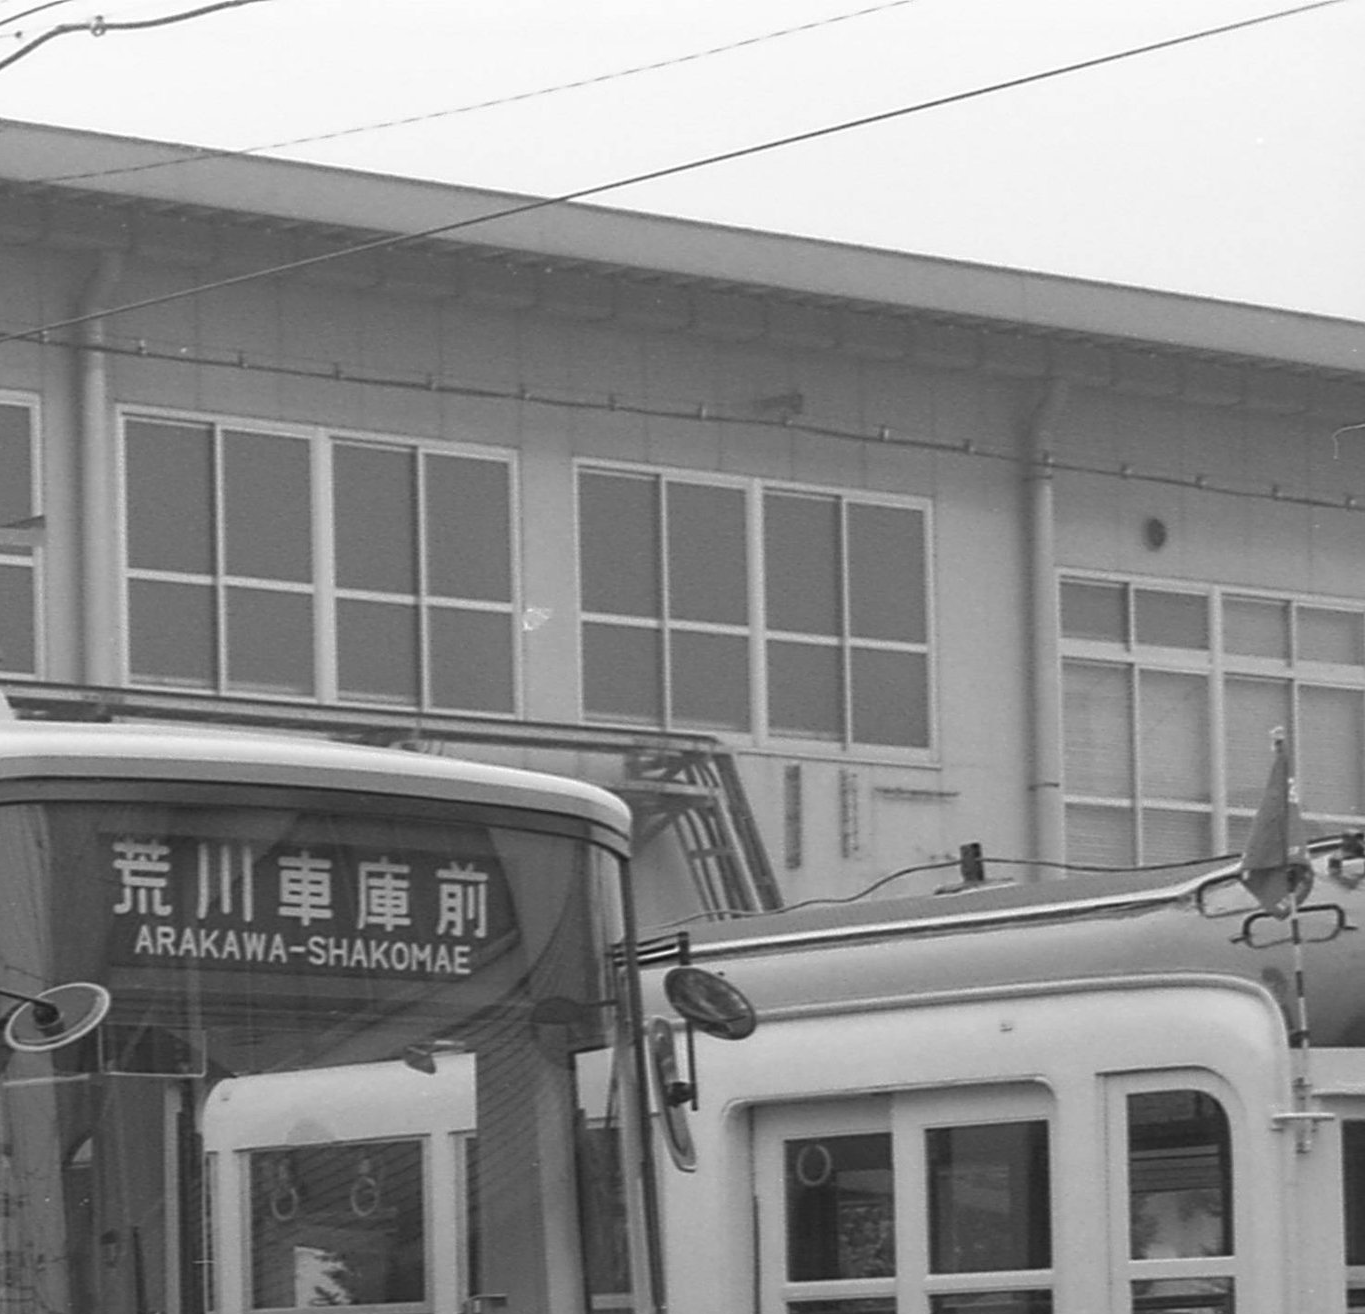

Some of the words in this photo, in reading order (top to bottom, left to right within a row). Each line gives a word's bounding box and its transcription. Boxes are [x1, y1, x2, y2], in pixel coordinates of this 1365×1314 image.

[113, 840, 489, 938] 荒川車庫前
[135, 925, 472, 975] ARAKAWA-SHAKOMAE
